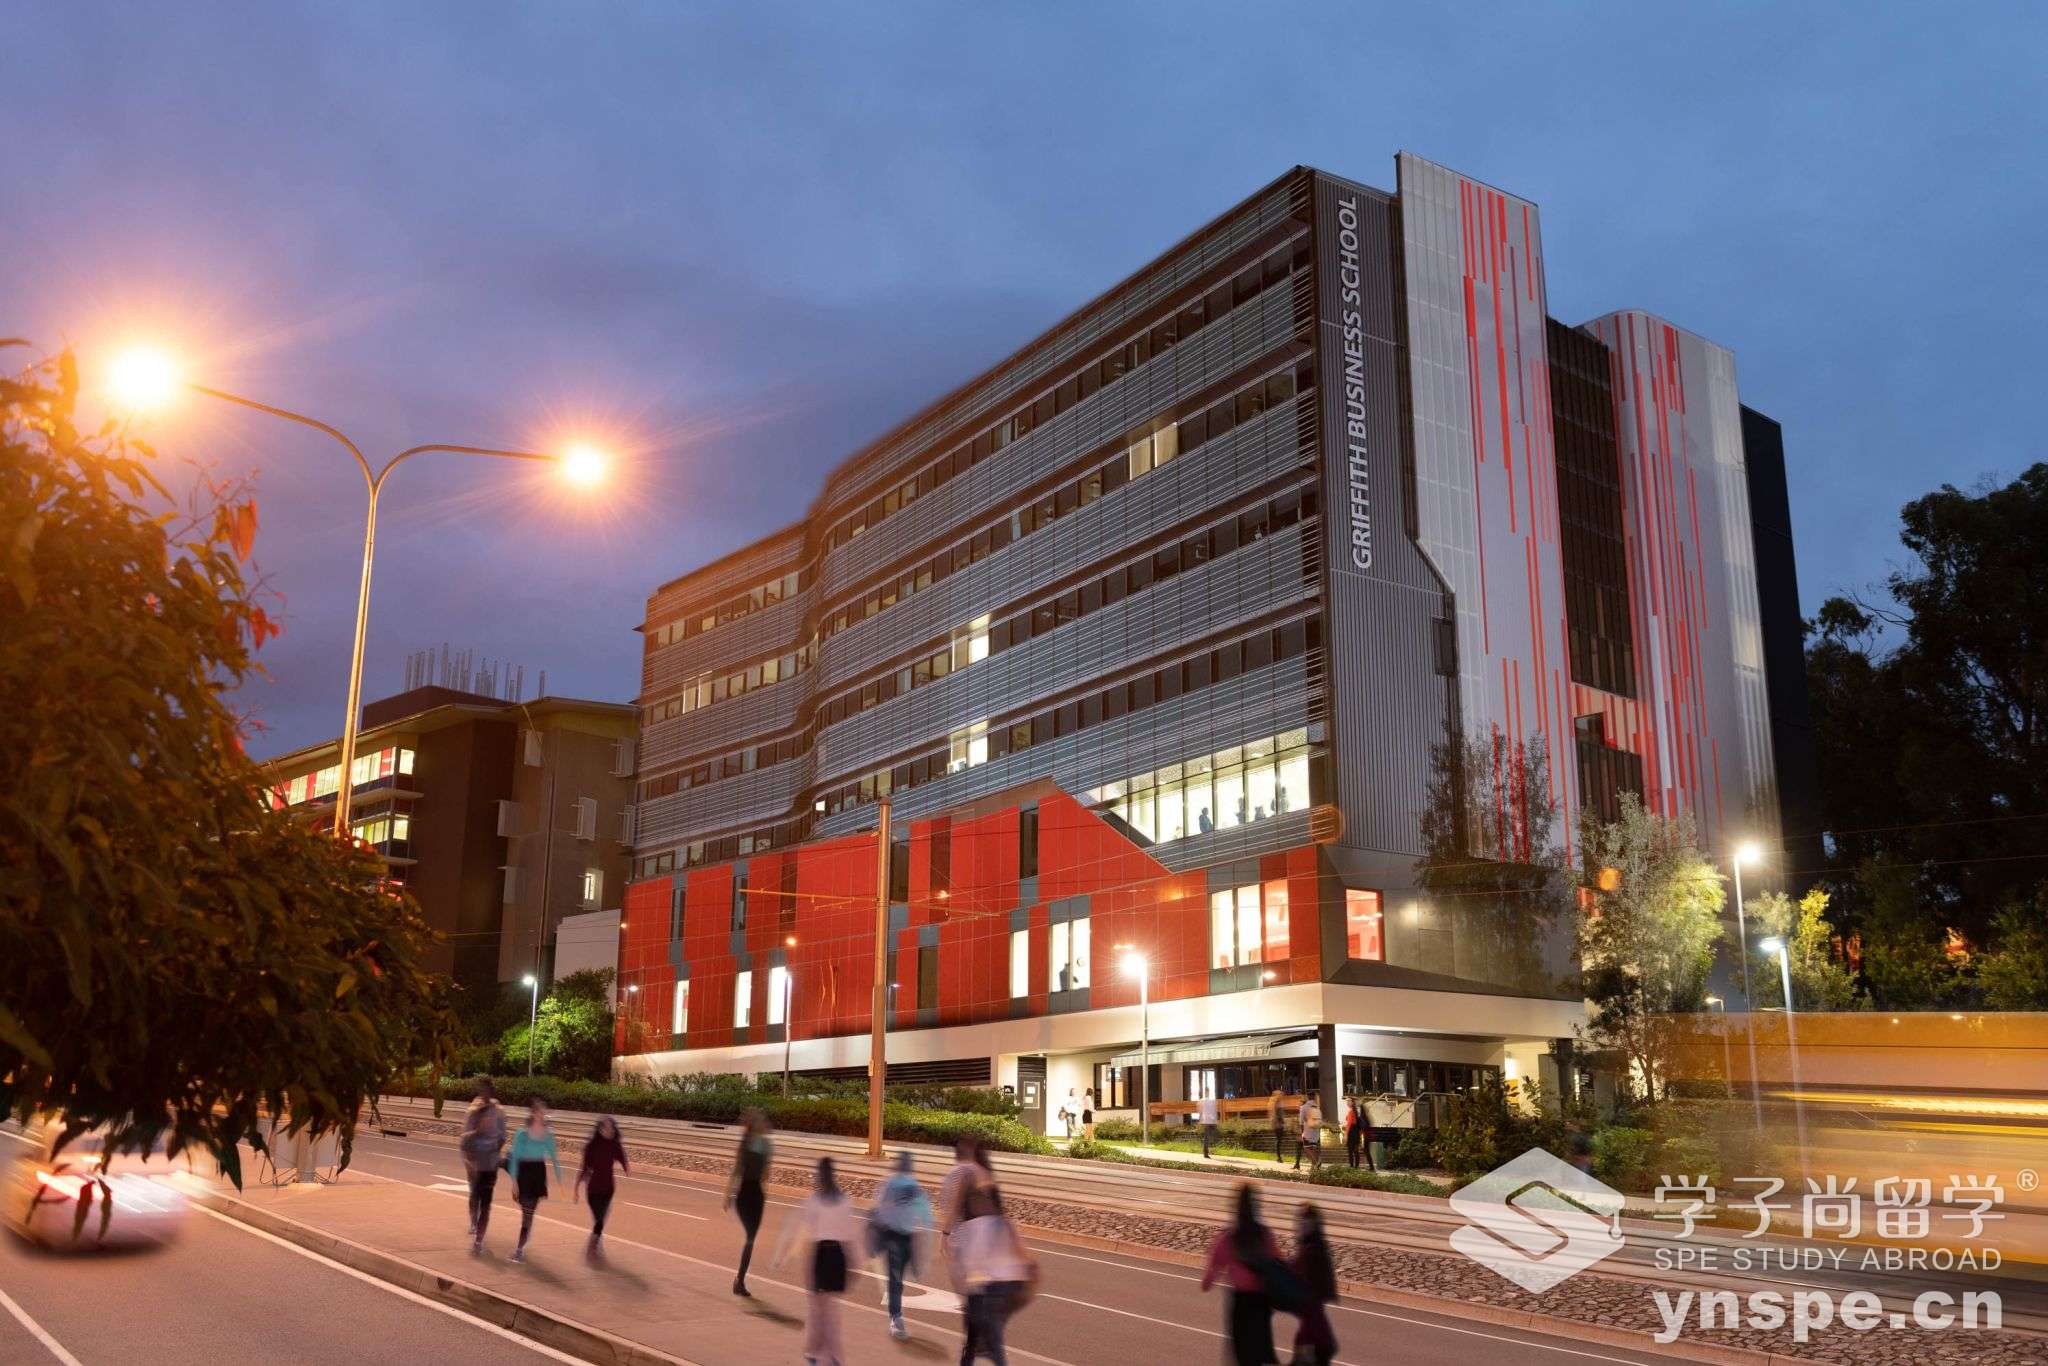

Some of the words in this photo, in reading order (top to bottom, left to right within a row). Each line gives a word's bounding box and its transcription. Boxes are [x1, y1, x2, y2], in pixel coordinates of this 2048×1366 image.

[1338, 196, 1361, 306] SCHOOL
[1343, 310, 1367, 440] BUSINESS
[1350, 443, 1373, 569] GRIFFITH
